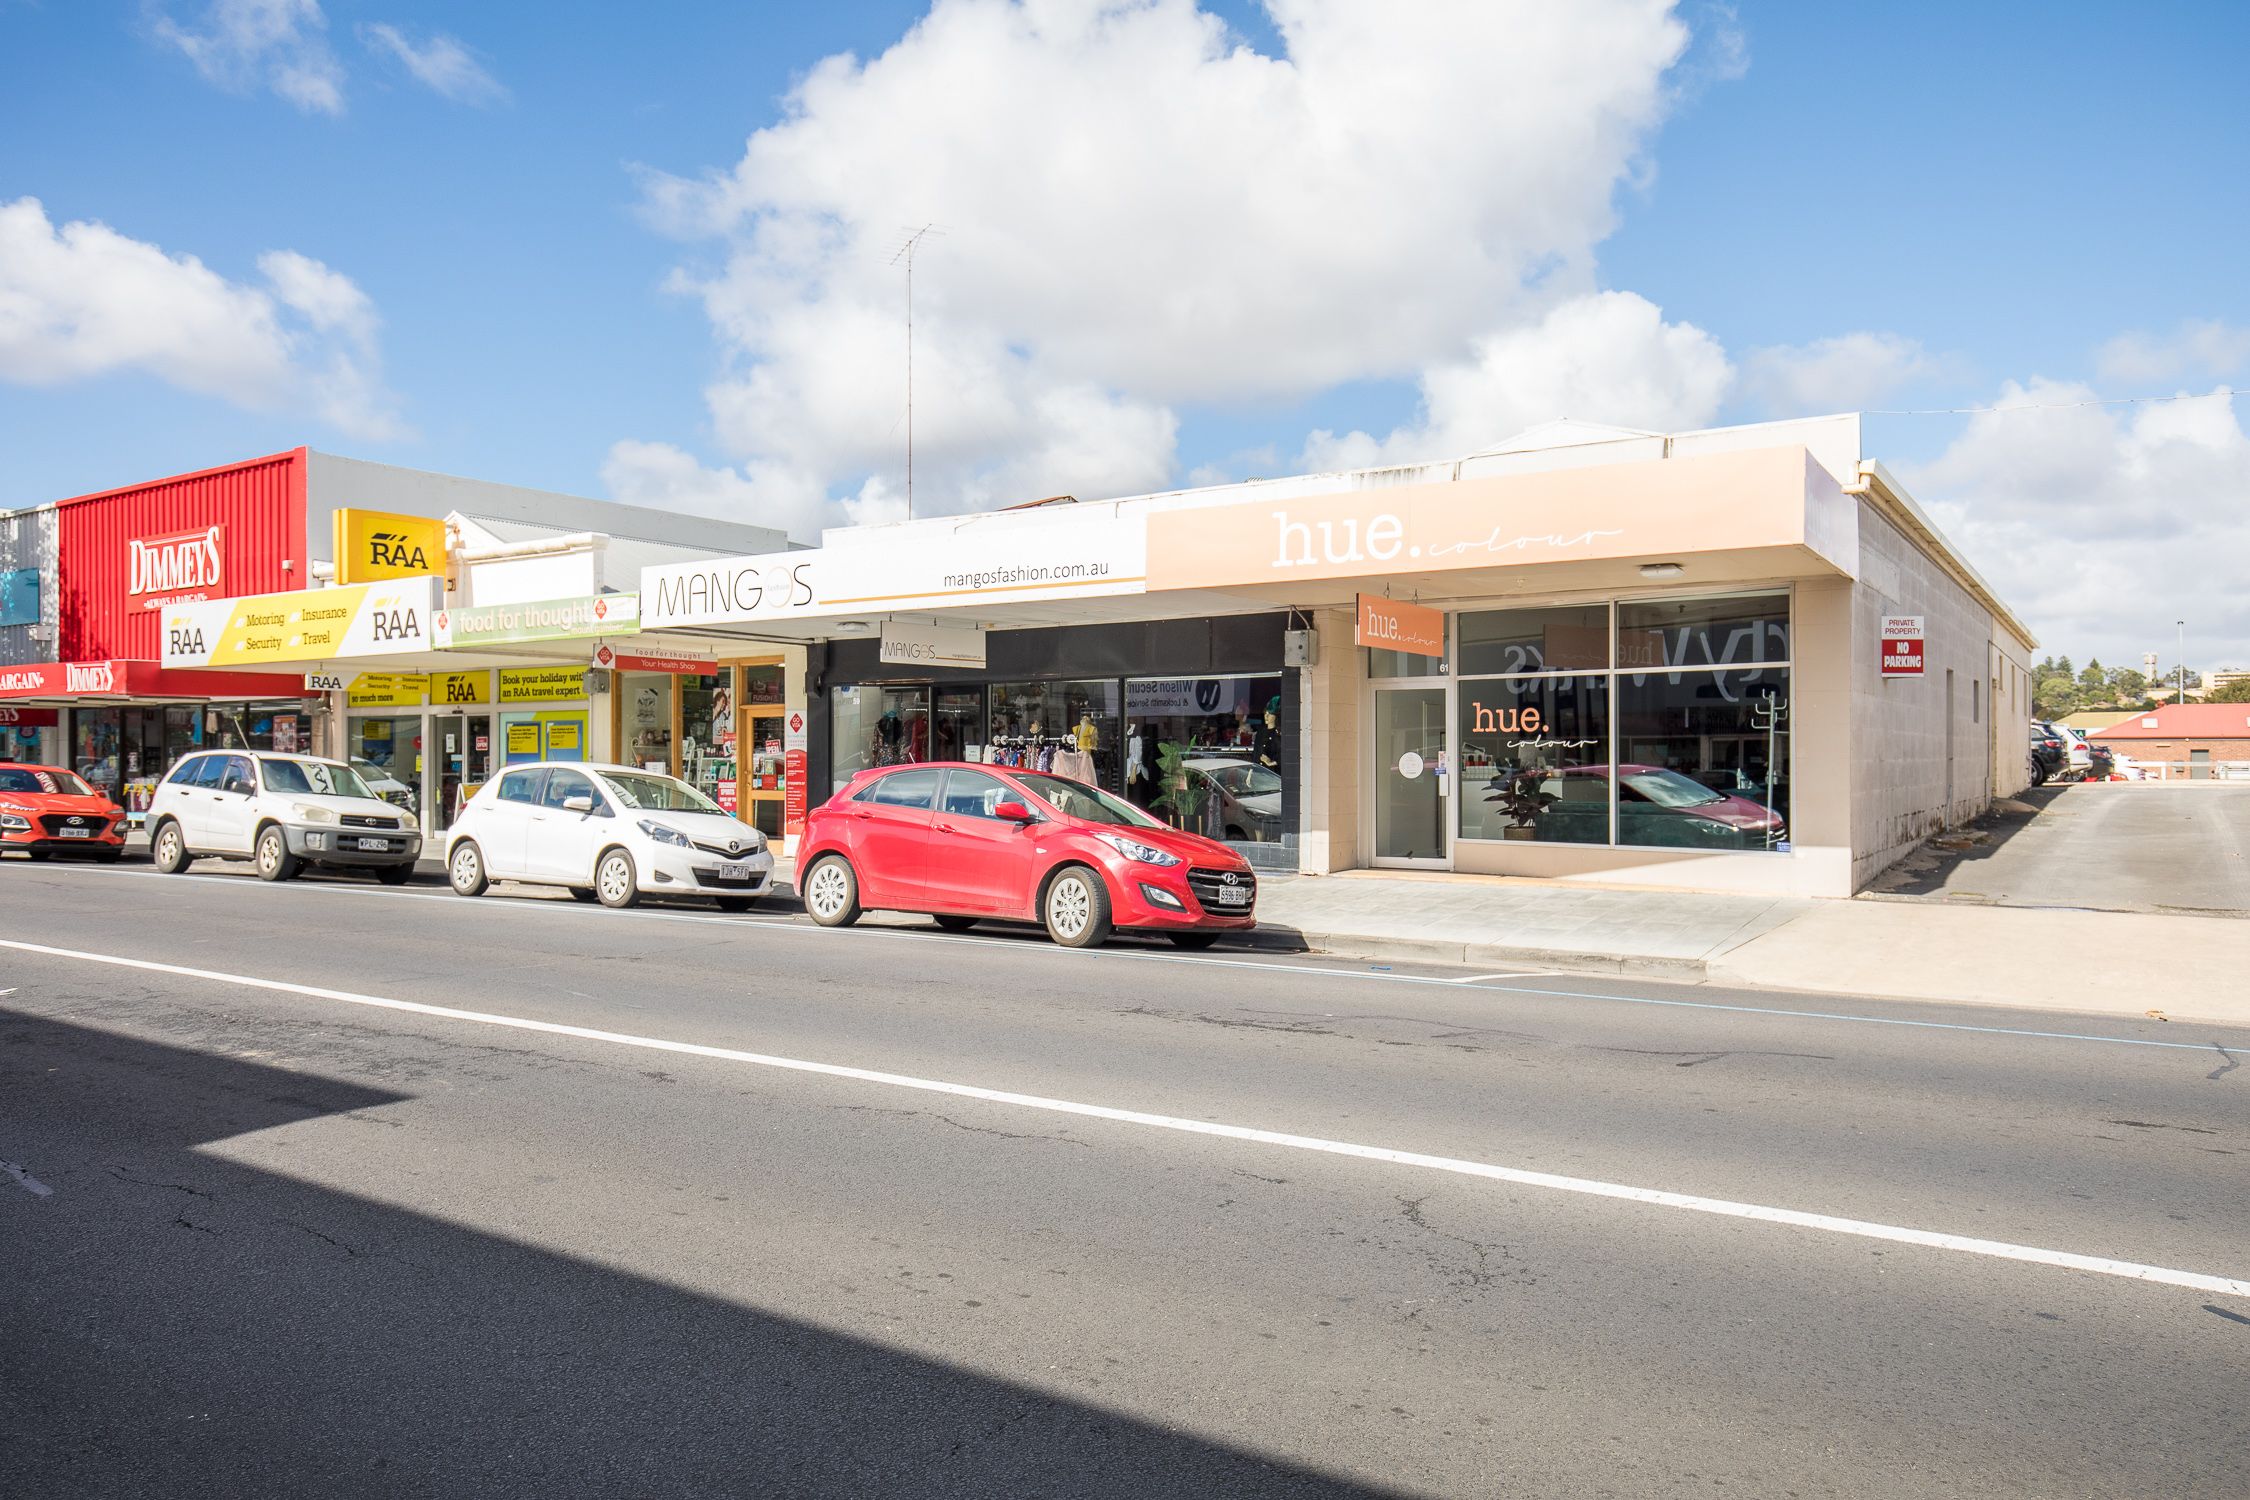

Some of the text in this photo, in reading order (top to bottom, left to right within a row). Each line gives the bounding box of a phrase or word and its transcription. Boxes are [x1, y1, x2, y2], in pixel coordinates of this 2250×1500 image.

[1271, 511, 1624, 568] hue. colour
[129, 526, 220, 595] DIMMEYS
[370, 542, 429, 569] RAA
[944, 563, 1109, 589] mangosfashion.com.au
[657, 563, 813, 616] MANGOS
[246, 606, 347, 627] Motoring Insurance
[373, 608, 421, 641] RAA
[459, 612, 494, 633] food
[498, 608, 521, 629] for
[525, 601, 591, 631] thought
[1367, 606, 1402, 640] hue.
[170, 628, 206, 655] RAA
[246, 631, 330, 651] Security Travel
[884, 641, 936, 659] MANGOS
[1896, 641, 1909, 654] NO
[641, 659, 696, 671] Your Health Shop
[670, 652, 701, 660] thought
[1884, 655, 1921, 667] PARKING
[66, 661, 114, 692] DIMMEYS
[1440, 664, 1449, 672] 61
[0, 671, 41, 690] ARGAIN
[311, 676, 342, 689] RAA
[502, 672, 583, 686] Book your holiday wit
[360, 694, 376, 702] much
[447, 683, 476, 701] RAA
[513, 688, 530, 697] RAA
[532, 687, 554, 696] travel
[555, 687, 580, 697] expert
[1472, 701, 1550, 733] hue.
[1507, 733, 1598, 748] colour
